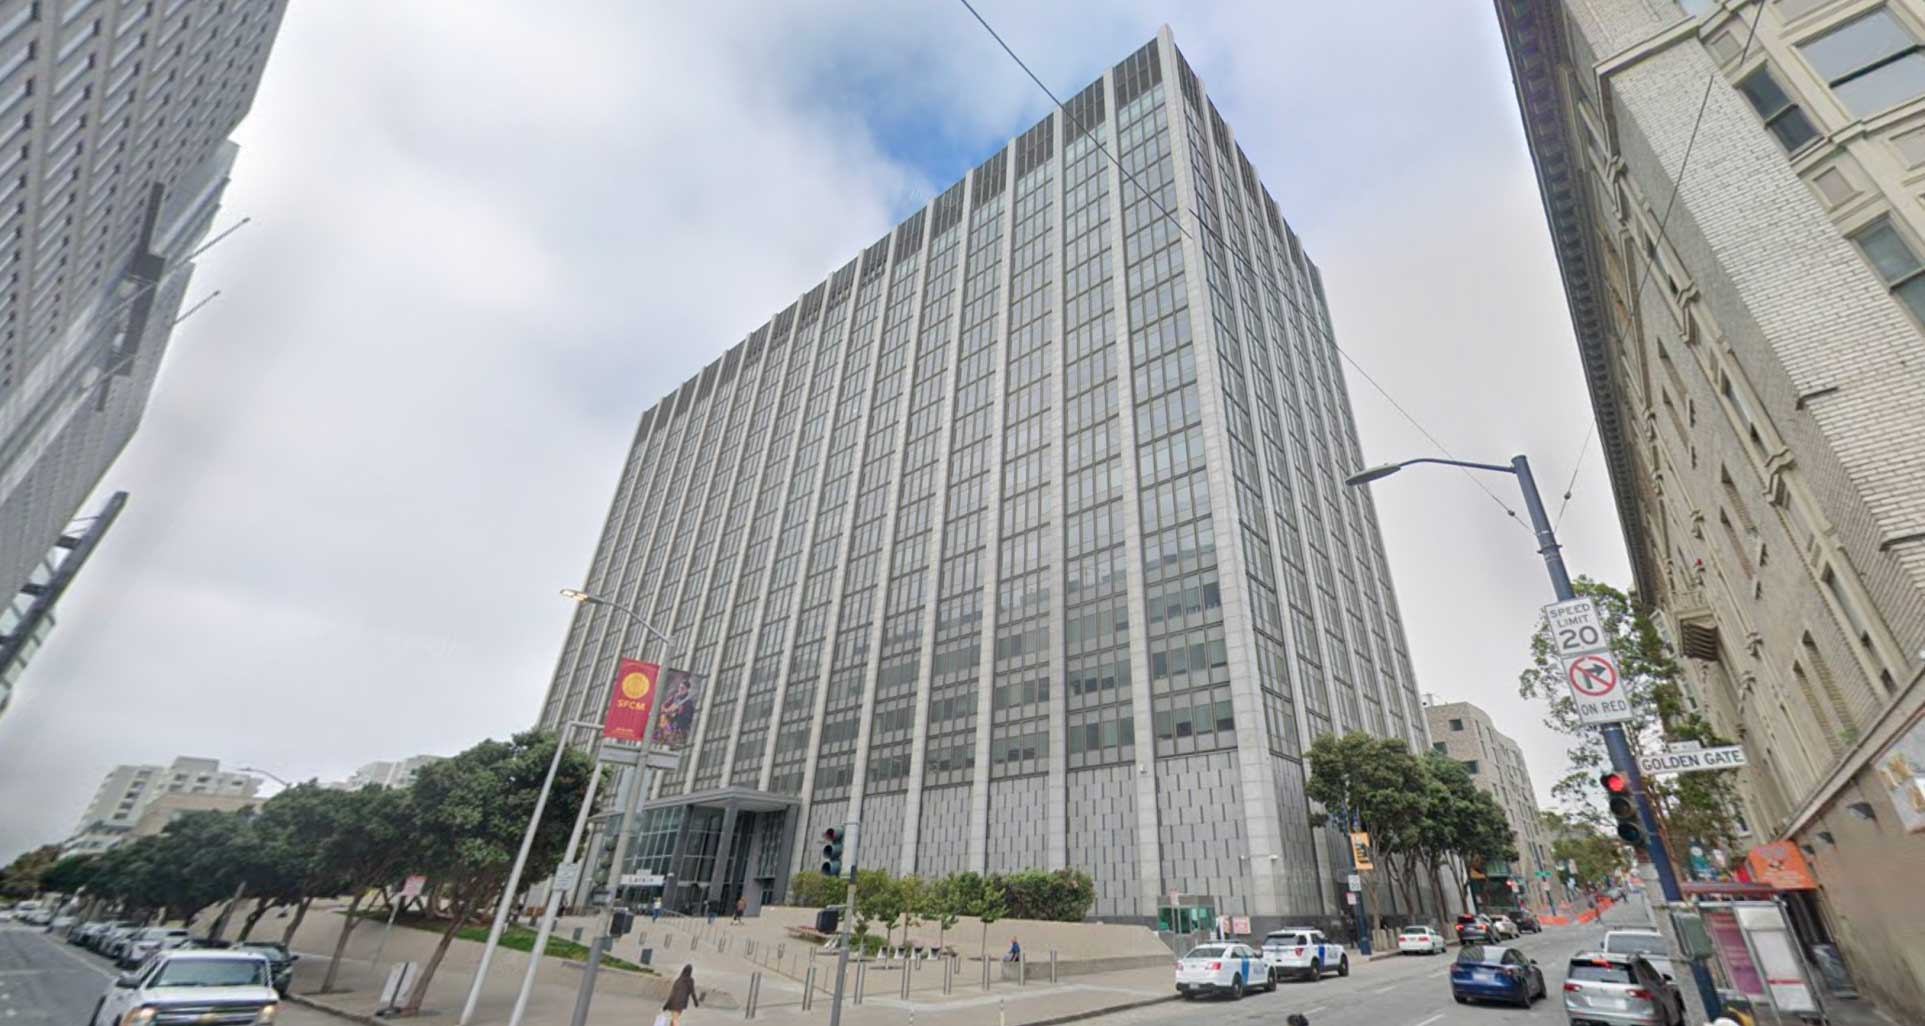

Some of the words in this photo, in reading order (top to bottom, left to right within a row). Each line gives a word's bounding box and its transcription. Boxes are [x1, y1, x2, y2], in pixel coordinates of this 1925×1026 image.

[1550, 603, 1590, 618] SPEED
[1557, 614, 1588, 628] LIMIT
[1559, 625, 1599, 650] 20
[617, 699, 646, 711] SFCM
[1581, 703, 1599, 716] ON
[1601, 700, 1627, 713] RED
[1641, 754, 1700, 771] GOLDEN
[1703, 750, 1745, 765] GATE
